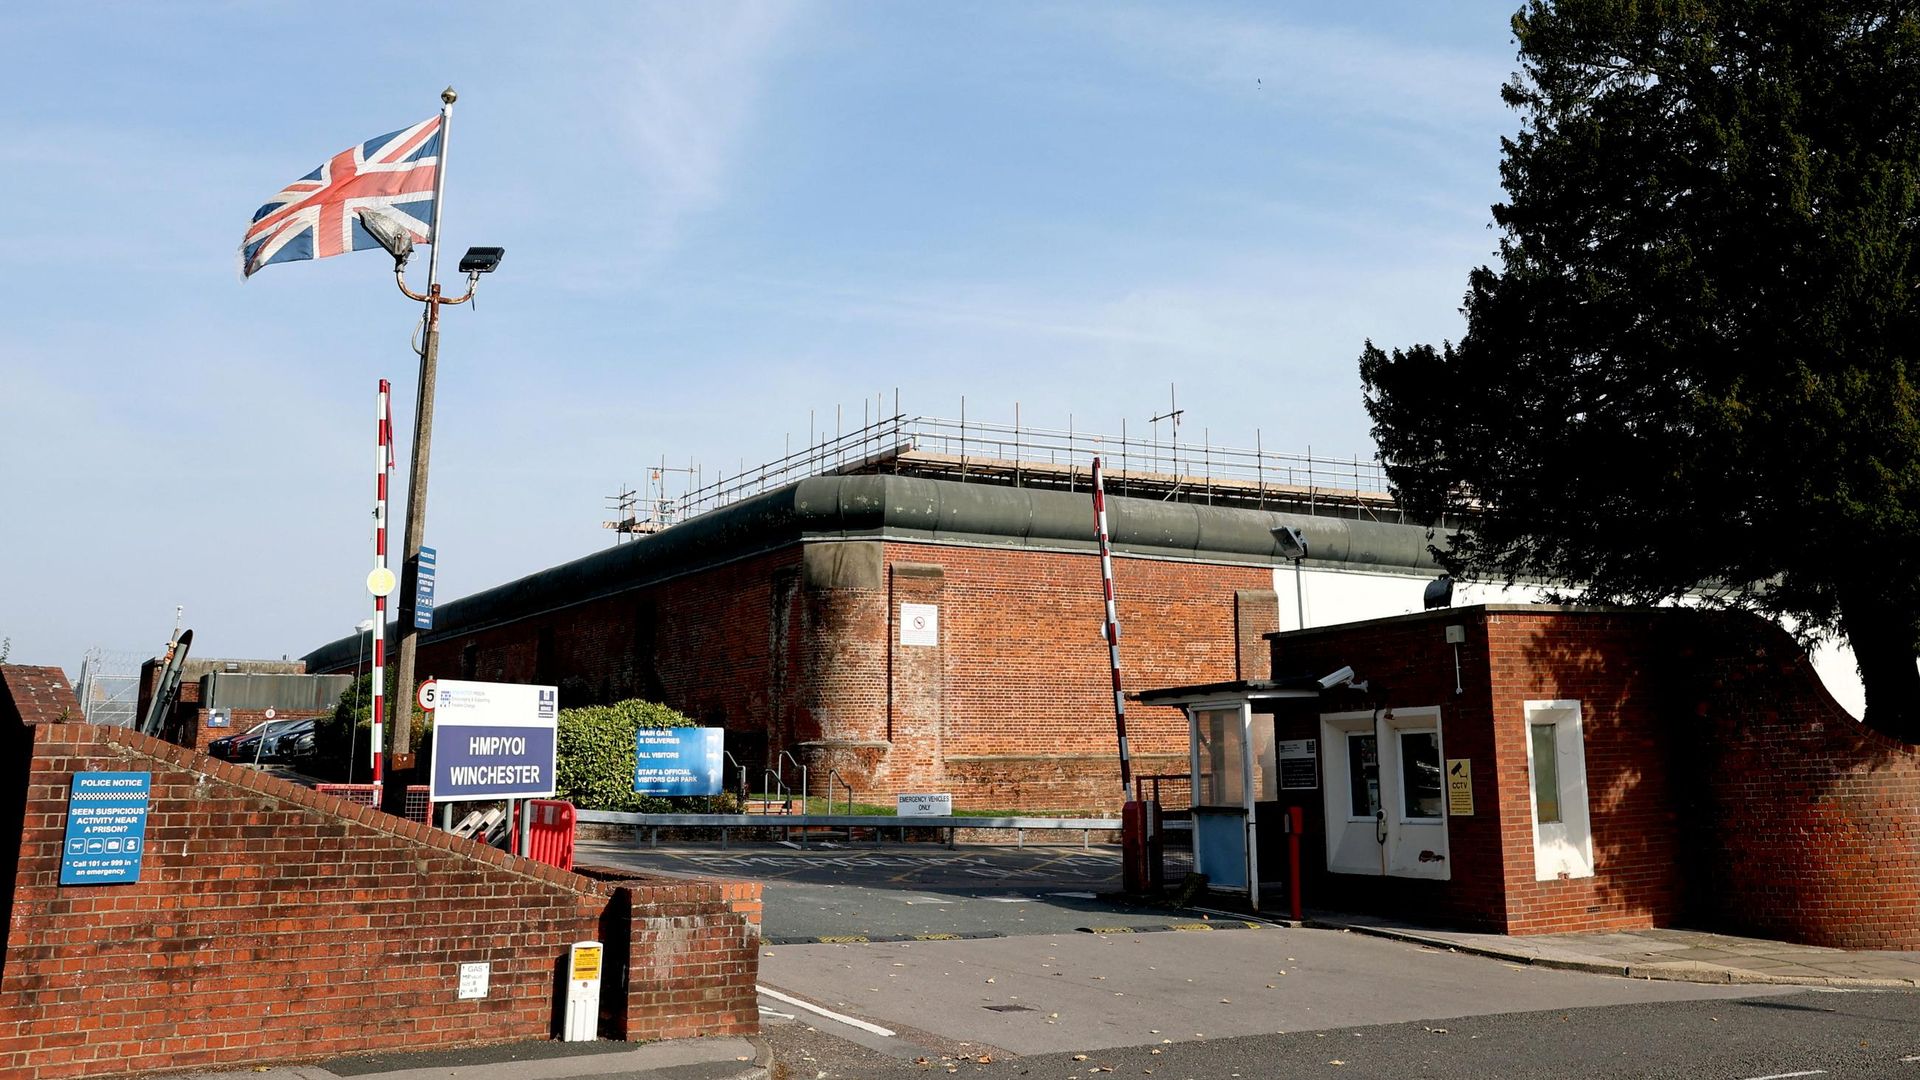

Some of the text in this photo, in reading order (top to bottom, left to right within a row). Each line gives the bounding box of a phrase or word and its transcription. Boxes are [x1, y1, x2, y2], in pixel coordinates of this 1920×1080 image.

[426, 689, 435, 702] 5
[469, 736, 526, 756] HMP/YOI
[450, 765, 541, 786] WINCHESTER
[680, 775, 698, 783] PARK
[80, 779, 111, 787] POLICE
[71, 807, 144, 816] SEEN SUSPICIOUS
[76, 816, 138, 825] ACTIVITY NEAR
[92, 825, 128, 833] PRISON?
[72, 860, 87, 868] Call
[467, 965, 483, 973] GAS
